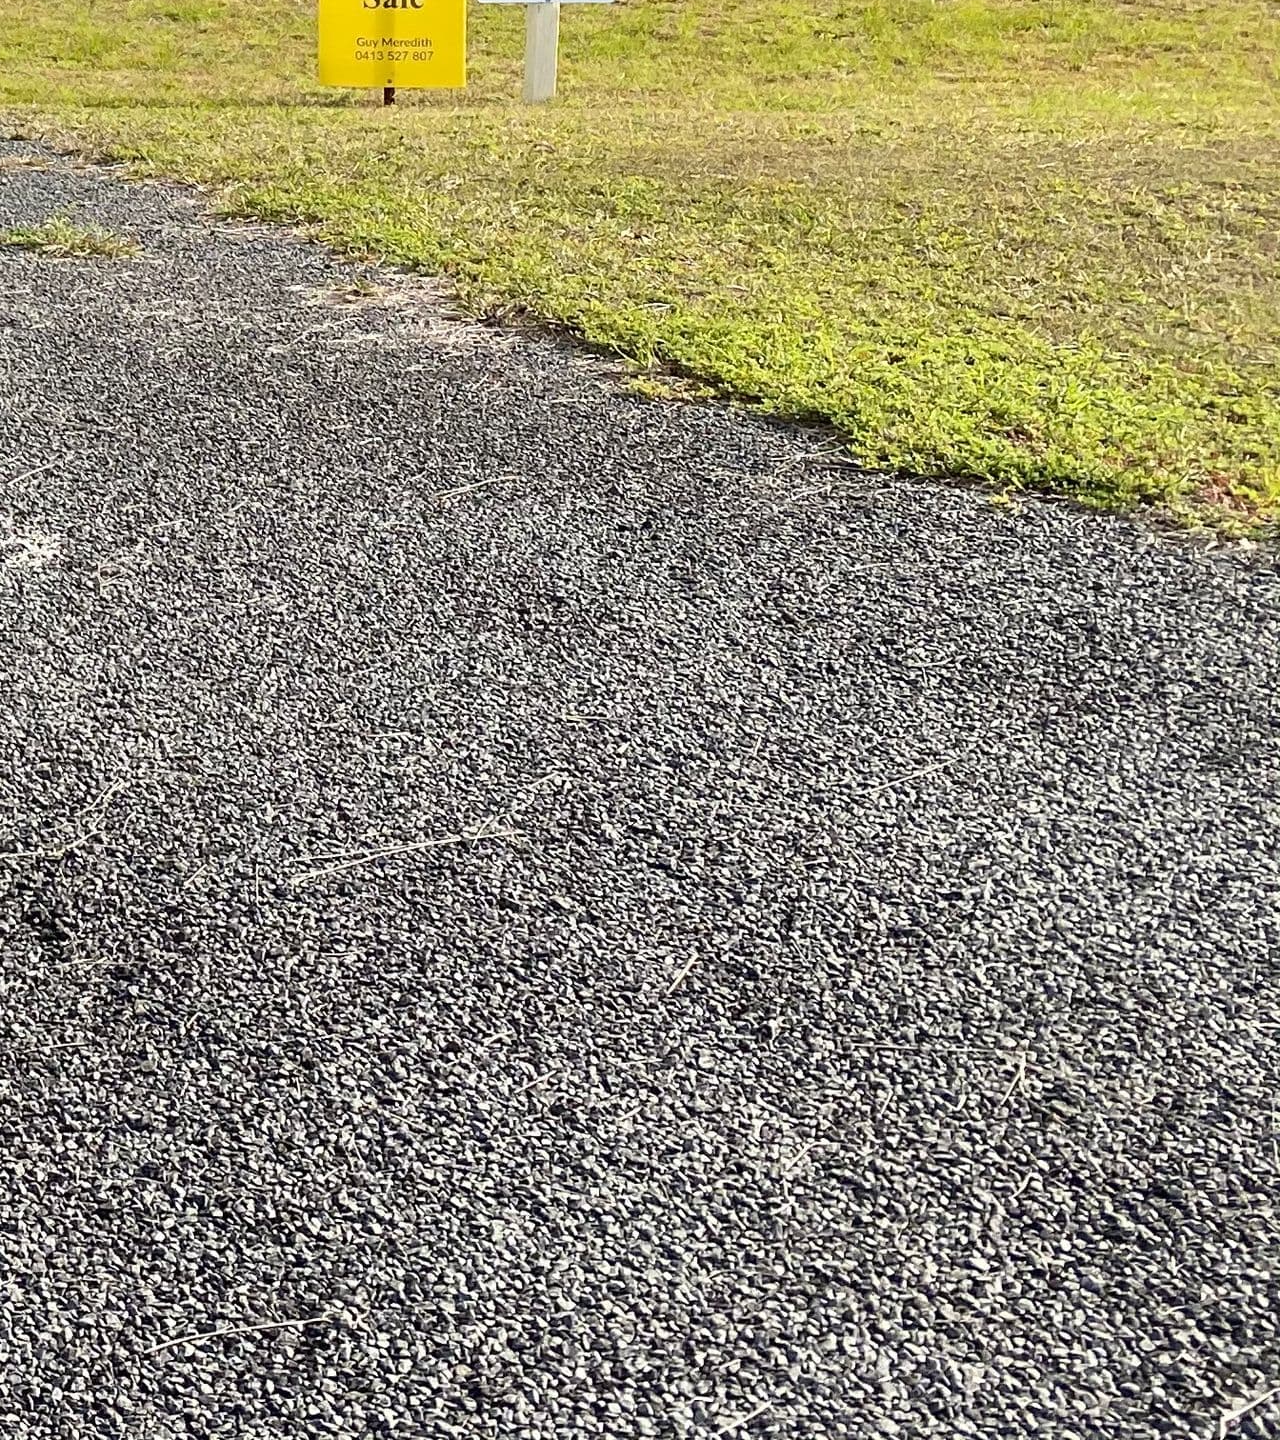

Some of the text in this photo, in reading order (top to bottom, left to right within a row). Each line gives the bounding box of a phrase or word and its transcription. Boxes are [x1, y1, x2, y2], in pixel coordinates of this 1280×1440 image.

[356, 37, 432, 48] Guy Meredith
[355, 50, 434, 61] 0413 527 807
